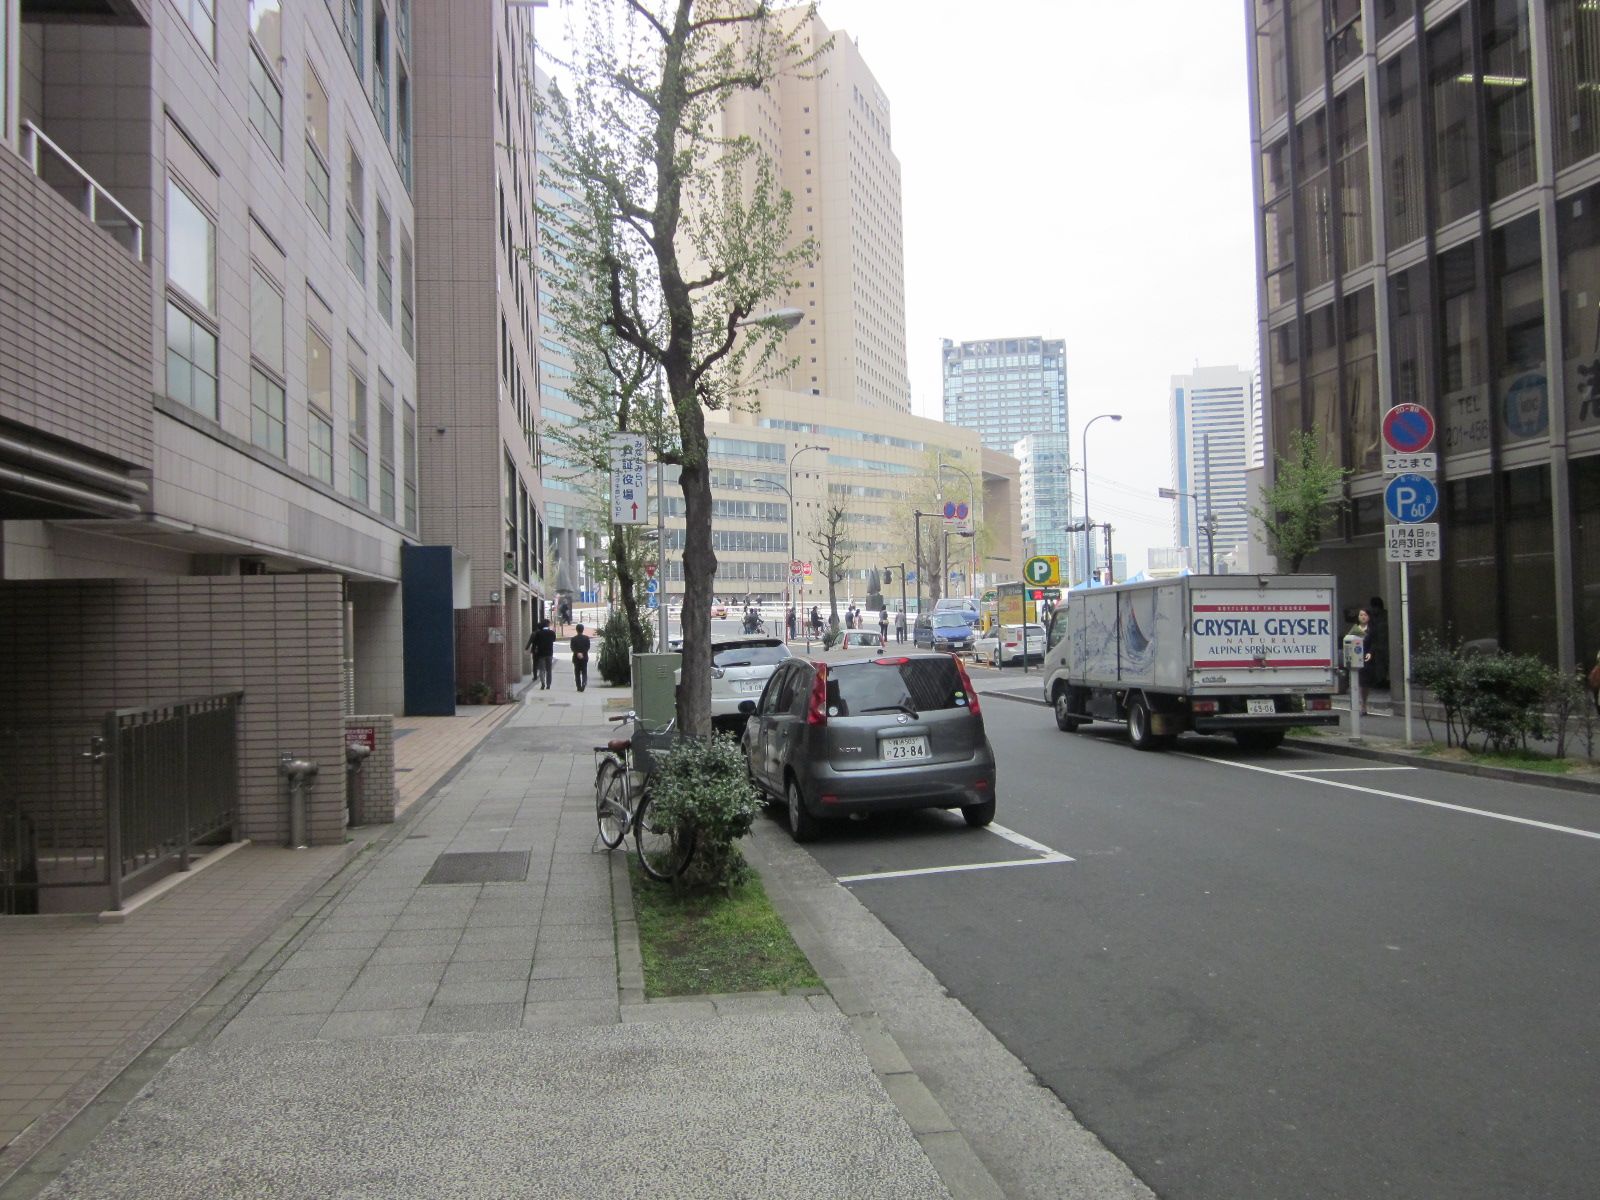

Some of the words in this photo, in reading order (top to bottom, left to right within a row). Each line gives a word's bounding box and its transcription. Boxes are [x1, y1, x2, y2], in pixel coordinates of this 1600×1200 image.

[1457, 395, 1481, 415] TEL
[634, 440, 643, 488] みなとみらい
[1387, 457, 1433, 469] ここまで
[1396, 487, 1417, 518] P
[1410, 503, 1426, 517] 60
[1391, 528, 1437, 538] 1月4日から
[1389, 538, 1437, 548] 12月31日まで
[1390, 549, 1435, 558] ここまで
[1033, 561, 1048, 581] P
[1193, 618, 1259, 636] CRYSTAL
[1264, 618, 1330, 636] GEYSER
[1208, 646, 1242, 655] ALPINE
[1245, 645, 1281, 654] SPRING
[1283, 645, 1317, 654] WATER
[892, 744, 923, 758] 23-84
